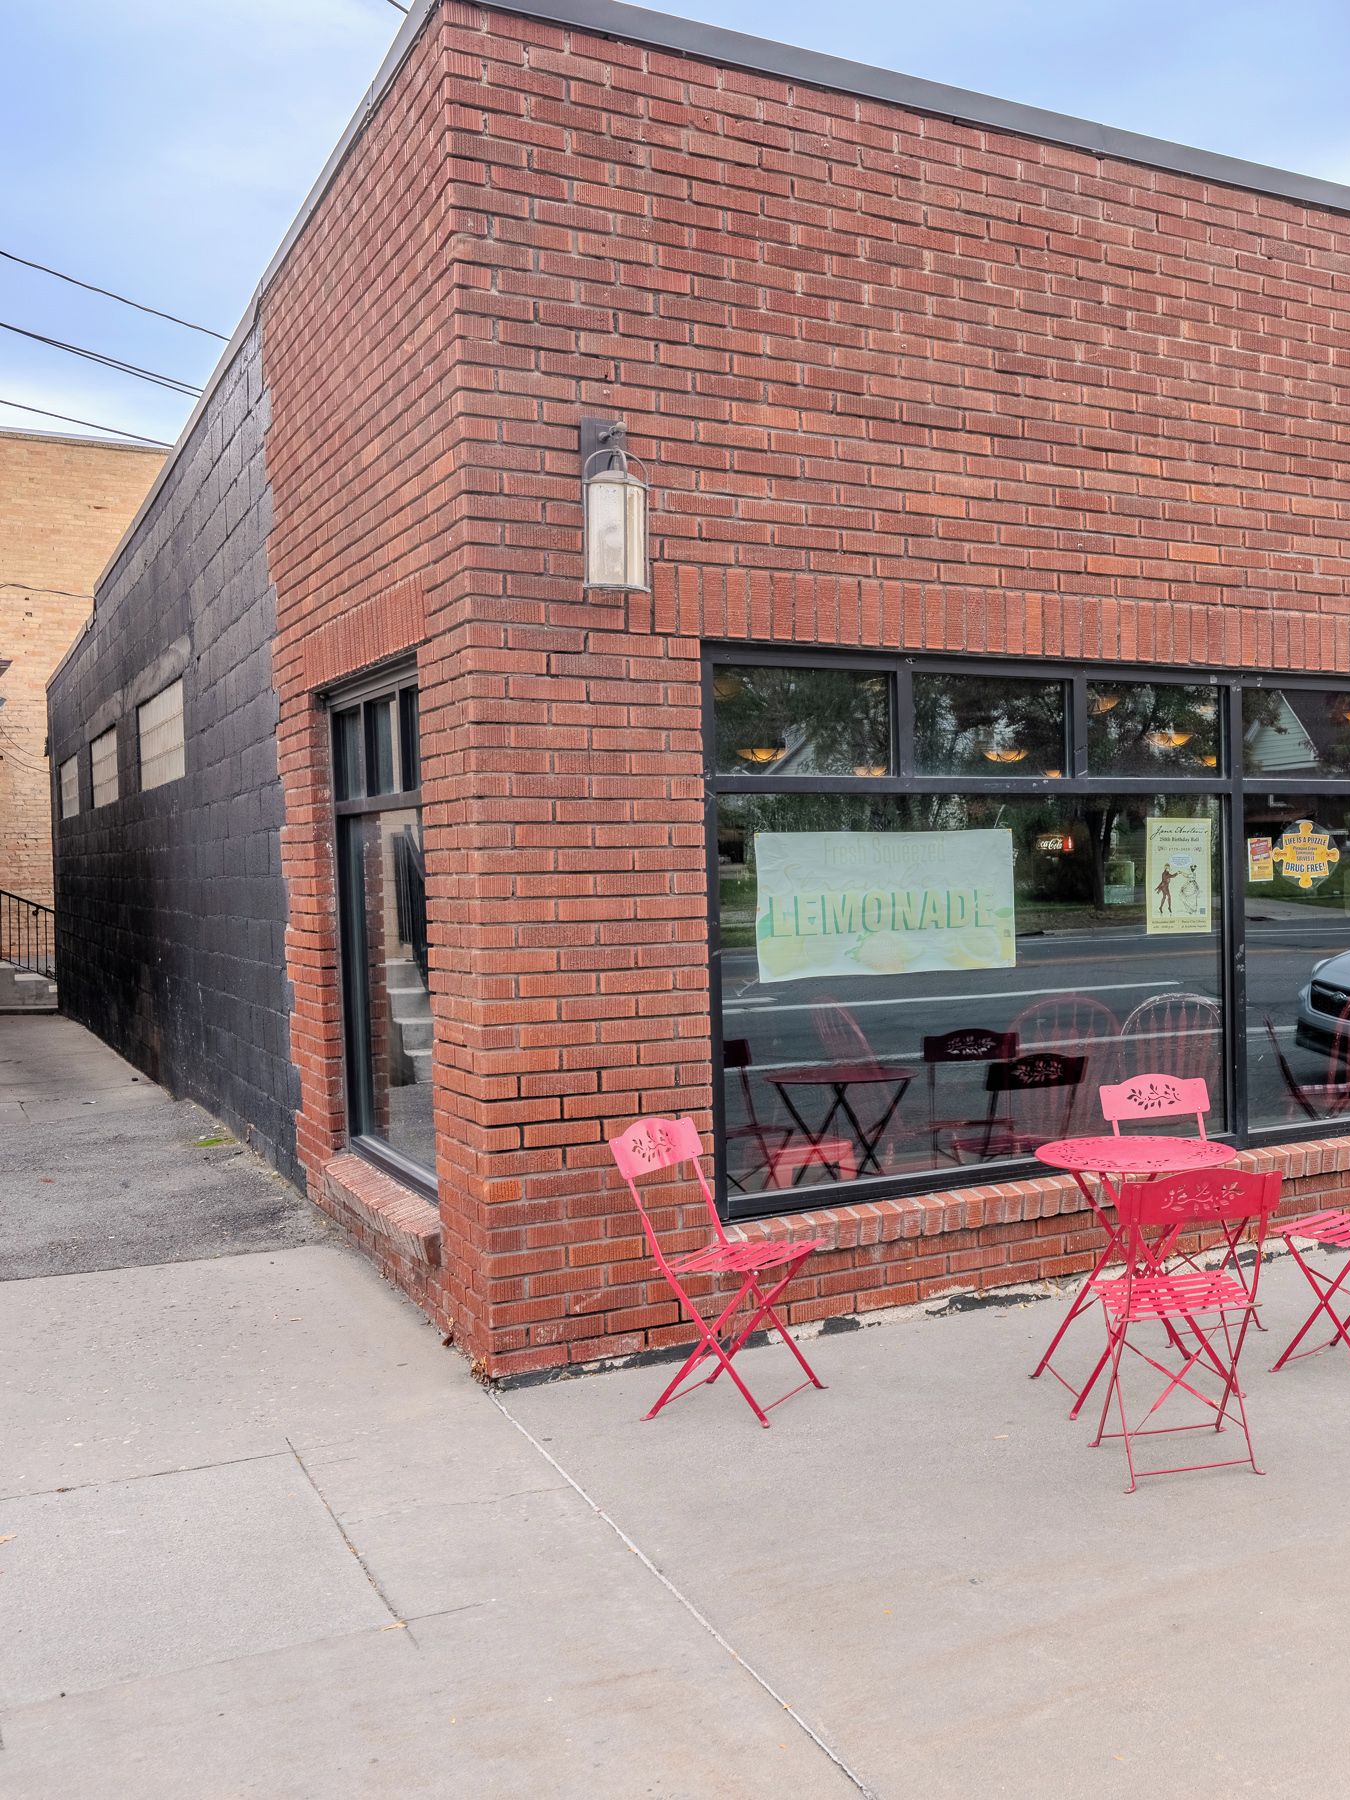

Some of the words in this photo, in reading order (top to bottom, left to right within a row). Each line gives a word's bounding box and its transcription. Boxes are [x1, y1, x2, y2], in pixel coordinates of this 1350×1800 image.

[824, 837, 867, 866] Fresh
[872, 835, 945, 867] Squeezed
[1285, 837, 1297, 846] LIFE
[1307, 836, 1327, 846] PUZZLE
[1285, 862, 1305, 872] DRUG
[1306, 862, 1326, 872] FREE!
[768, 888, 995, 938] LEMONADE
